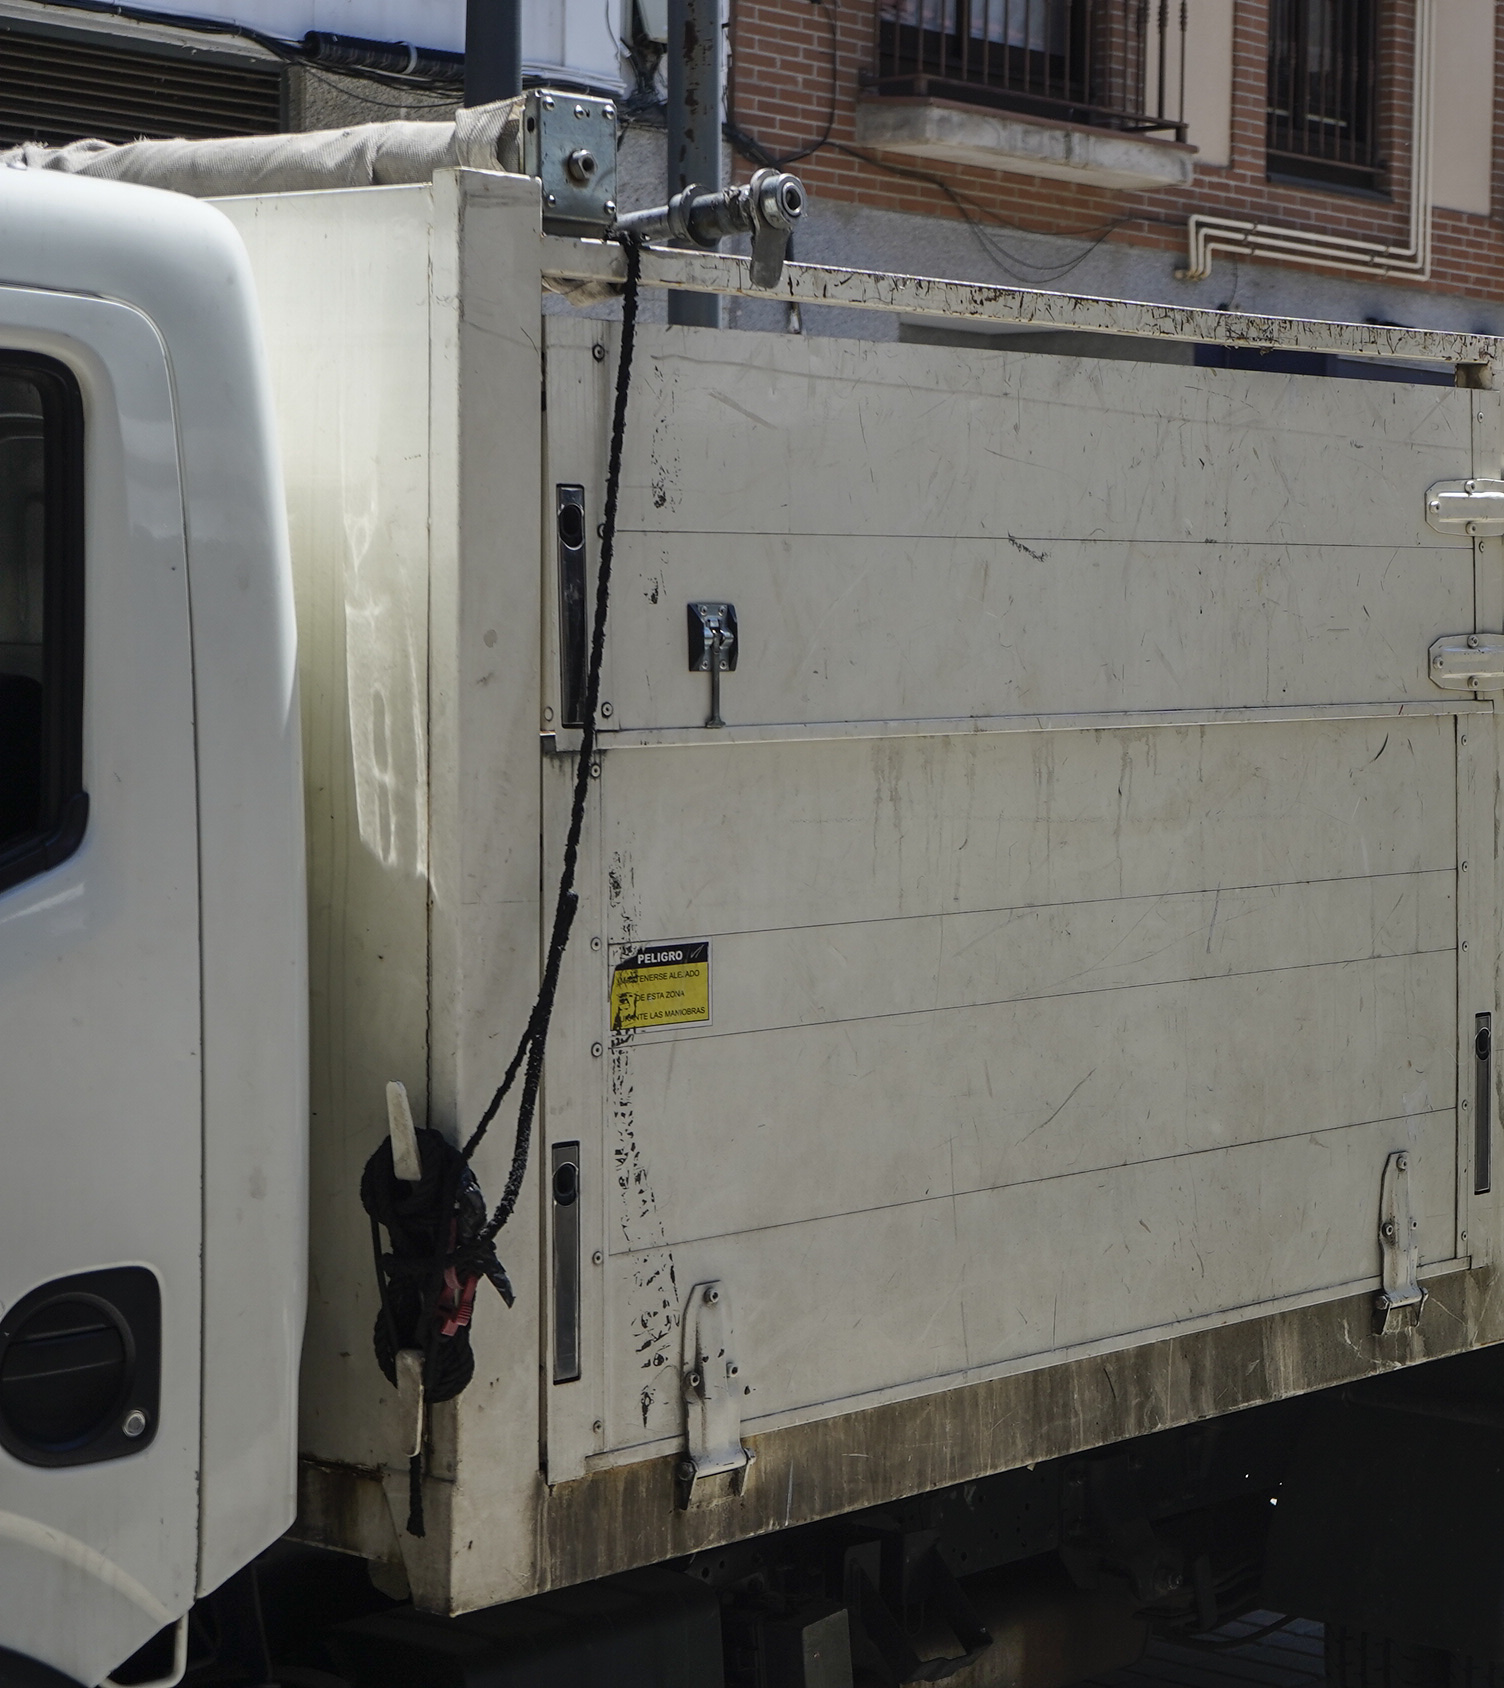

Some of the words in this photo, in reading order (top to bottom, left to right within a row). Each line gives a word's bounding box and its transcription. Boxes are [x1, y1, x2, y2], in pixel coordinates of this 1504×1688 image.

[637, 950, 683, 964] PELIGRO
[636, 992, 646, 1002] DE
[647, 991, 665, 1001] ESTA
[665, 990, 685, 999] ZONA
[649, 1010, 663, 1019] LAS
[664, 1006, 706, 1018] MANIOBRAS
